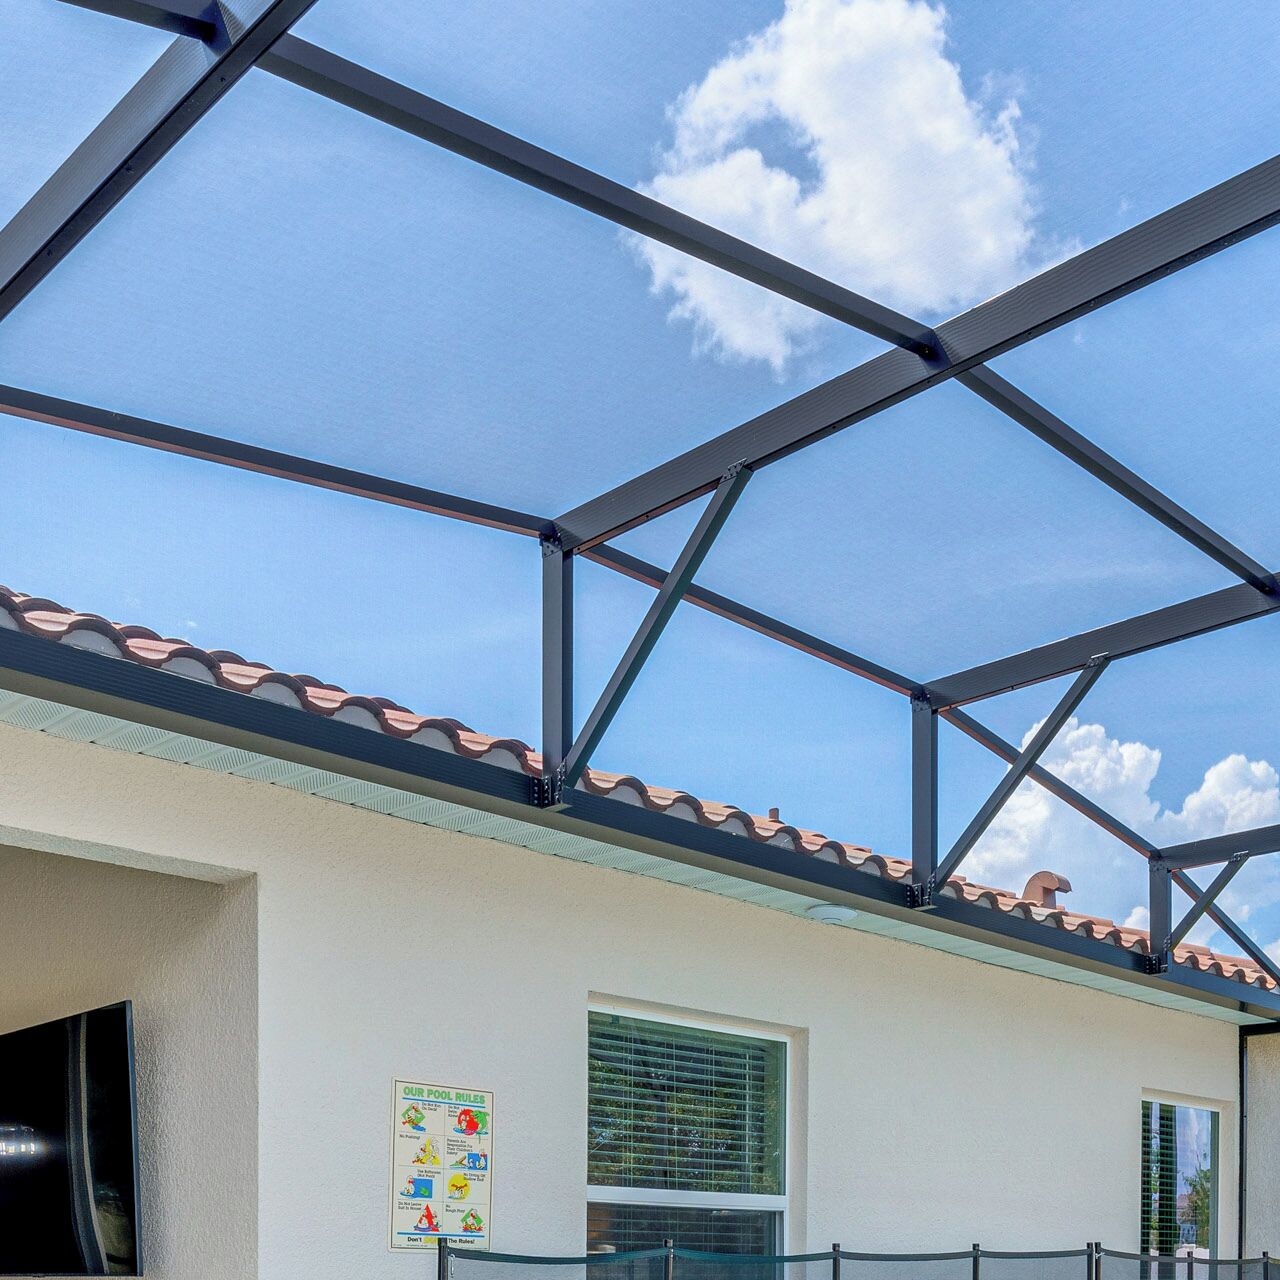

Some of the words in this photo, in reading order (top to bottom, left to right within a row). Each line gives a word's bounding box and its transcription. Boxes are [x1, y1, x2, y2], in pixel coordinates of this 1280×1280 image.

[403, 1086, 424, 1097] OUR
[427, 1088, 452, 1100] POOL
[455, 1092, 485, 1104] RULES
